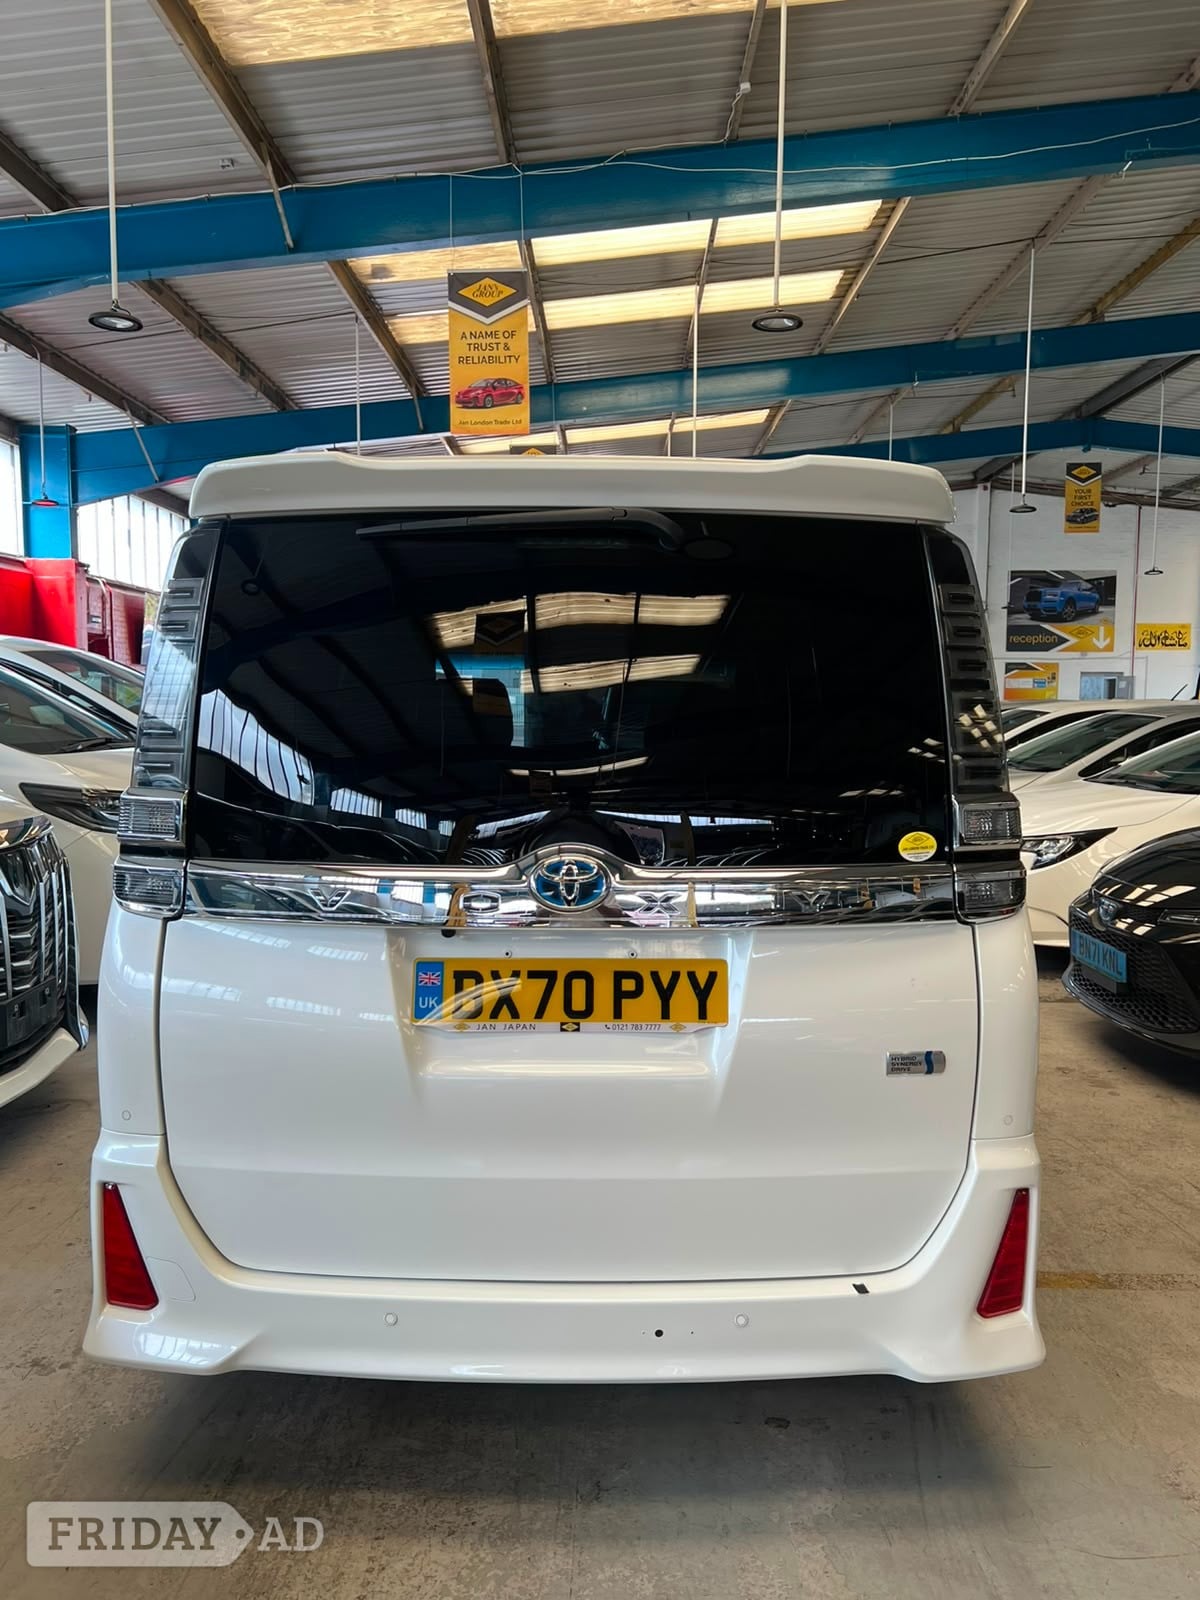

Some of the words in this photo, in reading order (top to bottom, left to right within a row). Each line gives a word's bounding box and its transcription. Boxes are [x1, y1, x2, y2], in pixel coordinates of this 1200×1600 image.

[472, 290, 503, 298] GROUP
[460, 331, 468, 340] A
[469, 330, 500, 340] NAME
[502, 330, 517, 340] OF
[466, 342, 501, 351] TRUST
[503, 342, 511, 351] &
[458, 354, 520, 365] RELIABILITY
[1009, 634, 1058, 646] reception
[418, 996, 439, 1009] UK
[613, 970, 718, 1020] PYY
[476, 1023, 496, 1031] JAN
[503, 1023, 536, 1031] JAPAN
